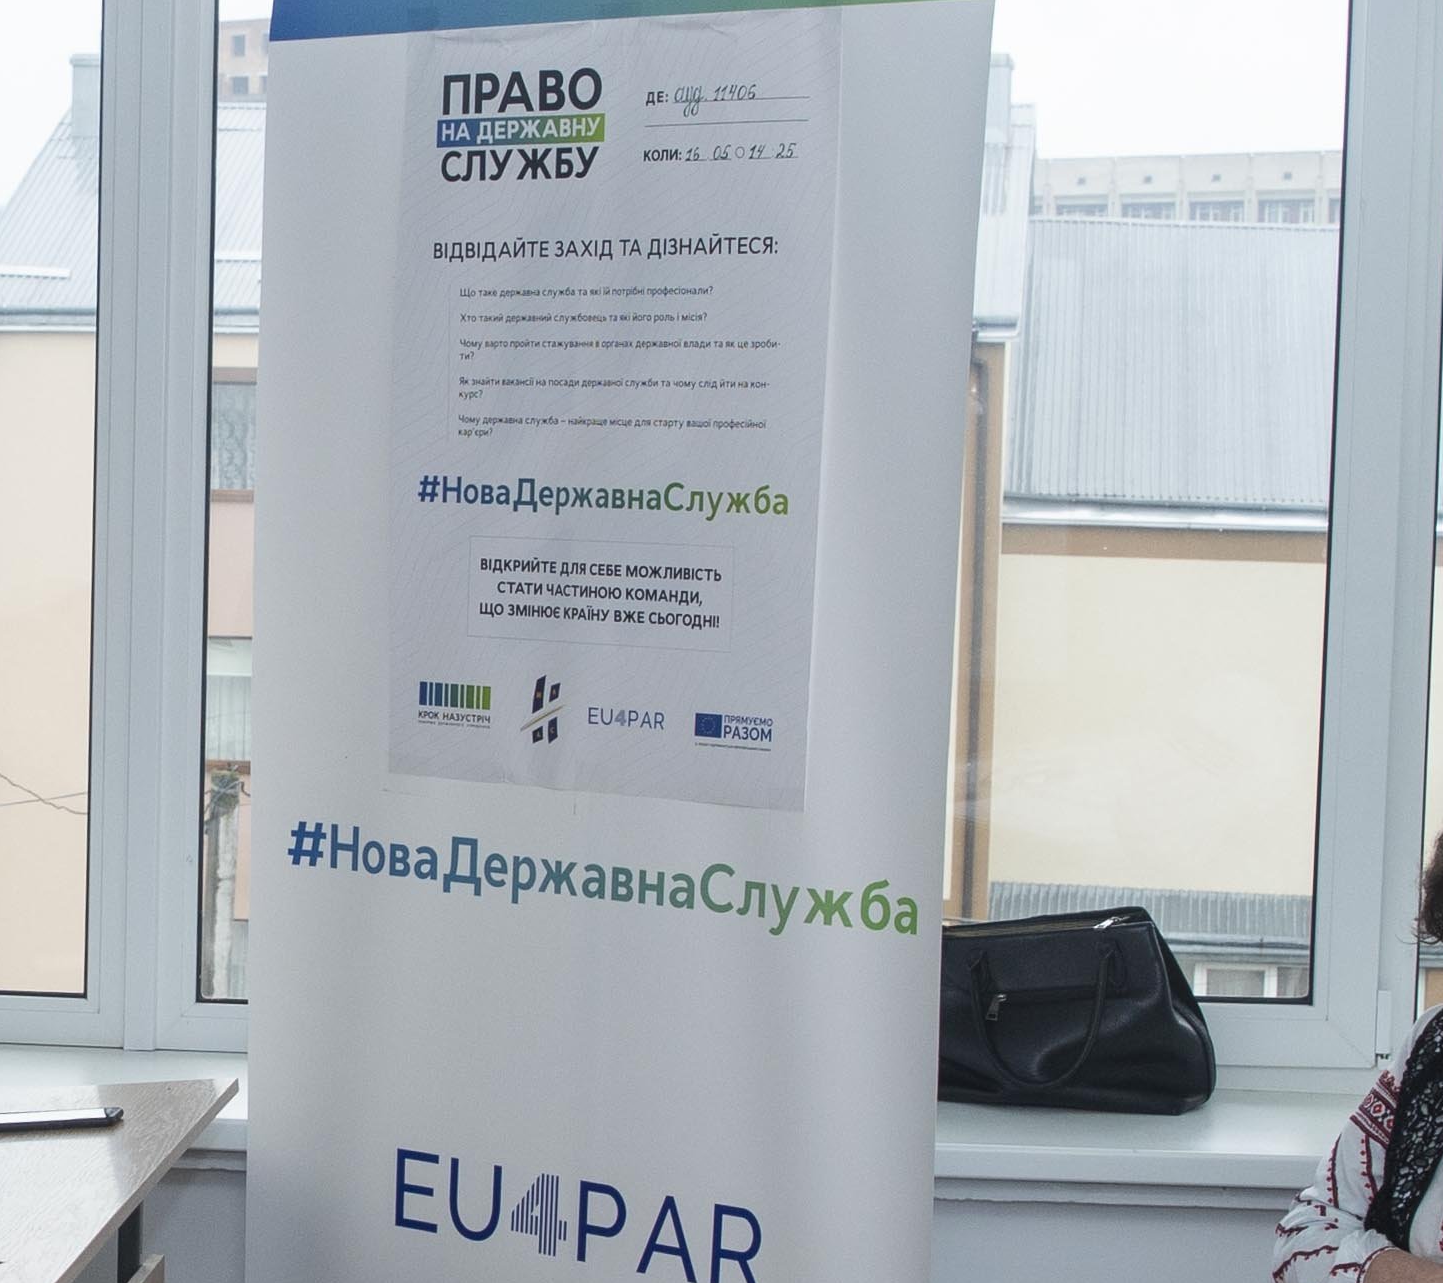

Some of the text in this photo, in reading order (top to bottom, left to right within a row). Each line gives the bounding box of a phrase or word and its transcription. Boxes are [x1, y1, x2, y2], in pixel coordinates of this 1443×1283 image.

[442, 67, 603, 115] ПРАВО
[645, 90, 669, 106] ДЕ:
[441, 116, 603, 145] НА ДЕРЖАВНУ
[643, 148, 683, 162] КОЛИ:
[440, 146, 600, 183] СЛУЖБУ
[433, 233, 779, 263] ВІДВІДАЙТЕ ЗАХІД ТА ДІЗНАЙТЕСЯ:
[459, 288, 476, 298] Що
[478, 289, 497, 297] таке
[499, 288, 540, 299] державна
[542, 287, 575, 299] служба
[578, 288, 588, 297] та
[611, 286, 645, 298] потрібні
[647, 285, 714, 299] професіонали?
[460, 313, 477, 323] Хто
[479, 313, 503, 322] такий
[505, 312, 552, 324] державний
[459, 338, 483, 350] Чому
[459, 351, 475, 361] ти?
[459, 377, 469, 386] Як
[471, 376, 500, 386] знайти
[548, 379, 580, 388] посади
[625, 378, 659, 390] служби
[458, 390, 483, 400] курс?
[458, 415, 481, 426] Чому
[482, 416, 523, 426] державна
[524, 416, 559, 426] служба
[418, 474, 789, 521] #НоваДержавнаСлужба
[480, 557, 722, 582] ВІДКРИЙТЕ ДЛЯ СЕБЕ МОЖЛИВІСТЬ
[497, 581, 703, 607] СТАТИ ЧАСТИНОЮ КОМАНДИ,
[479, 602, 720, 630] ЩО ЗМІНЮЄ КРАЇНУ ВЖЕ СЬОГОДНІ!
[417, 710, 440, 720] КРОК
[587, 706, 665, 730] EU4PAR
[723, 725, 772, 742] РАЗОМ
[286, 820, 919, 937] #НоваДержавнаСлужба
